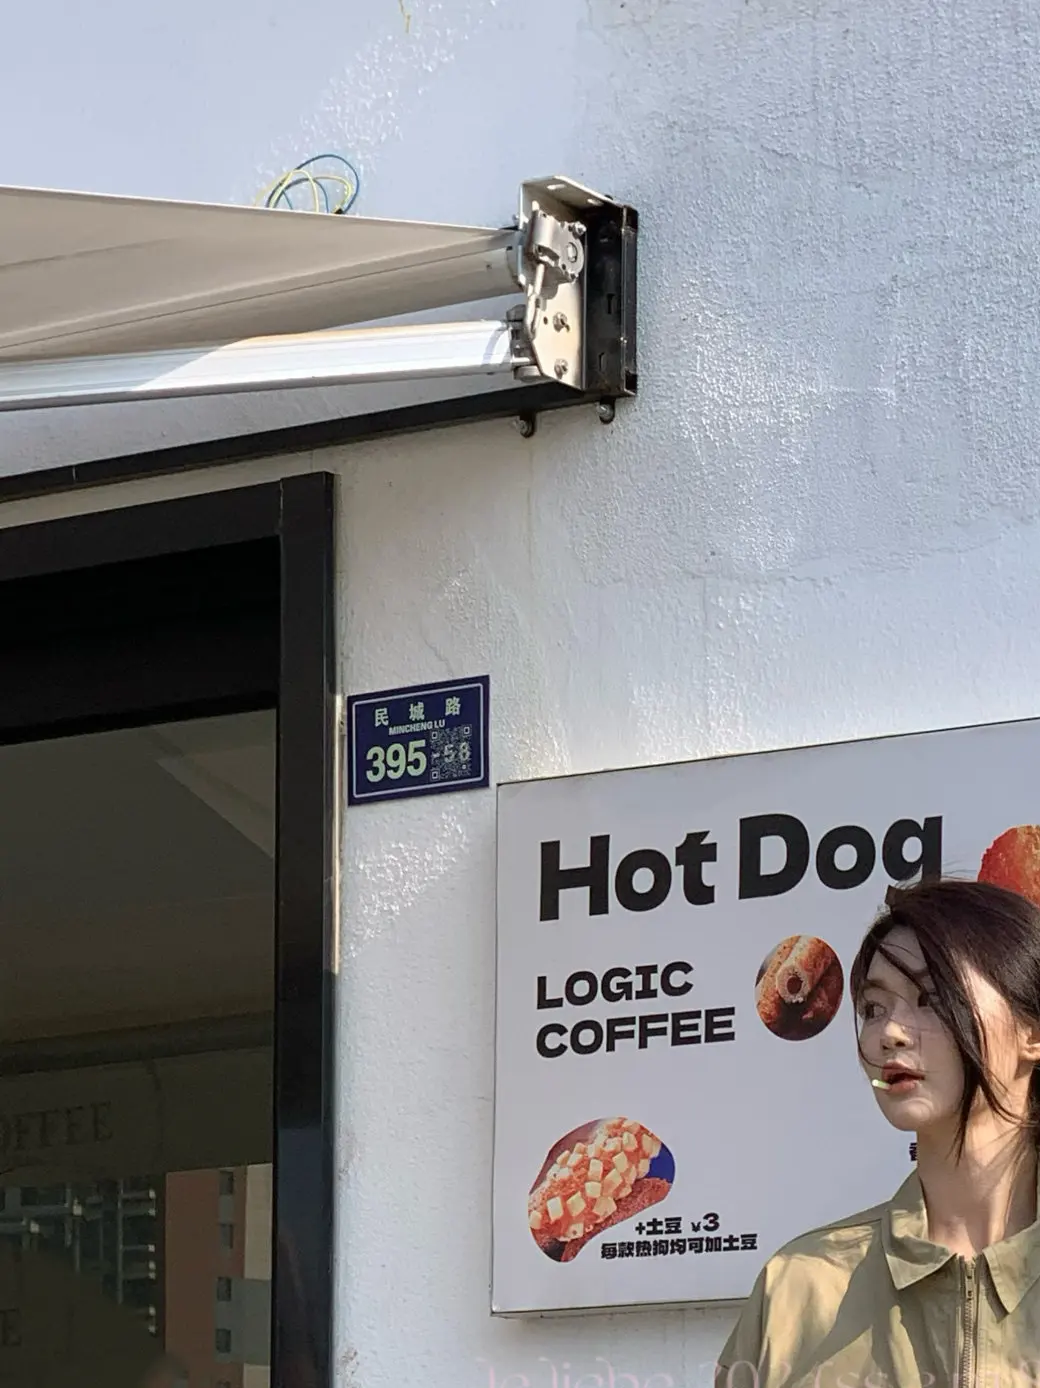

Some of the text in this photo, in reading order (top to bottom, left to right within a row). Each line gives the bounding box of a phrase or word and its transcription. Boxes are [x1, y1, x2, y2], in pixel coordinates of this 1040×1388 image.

[374, 696, 461, 727] 民城路
[388, 719, 446, 736] MINCHENG LU
[366, 739, 427, 782] 395
[539, 812, 944, 922] Hot Dog
[535, 961, 694, 1010] LOGIC
[535, 1006, 736, 1059] COFFEE
[600, 1233, 758, 1260] 每款热狗均可加土豆
